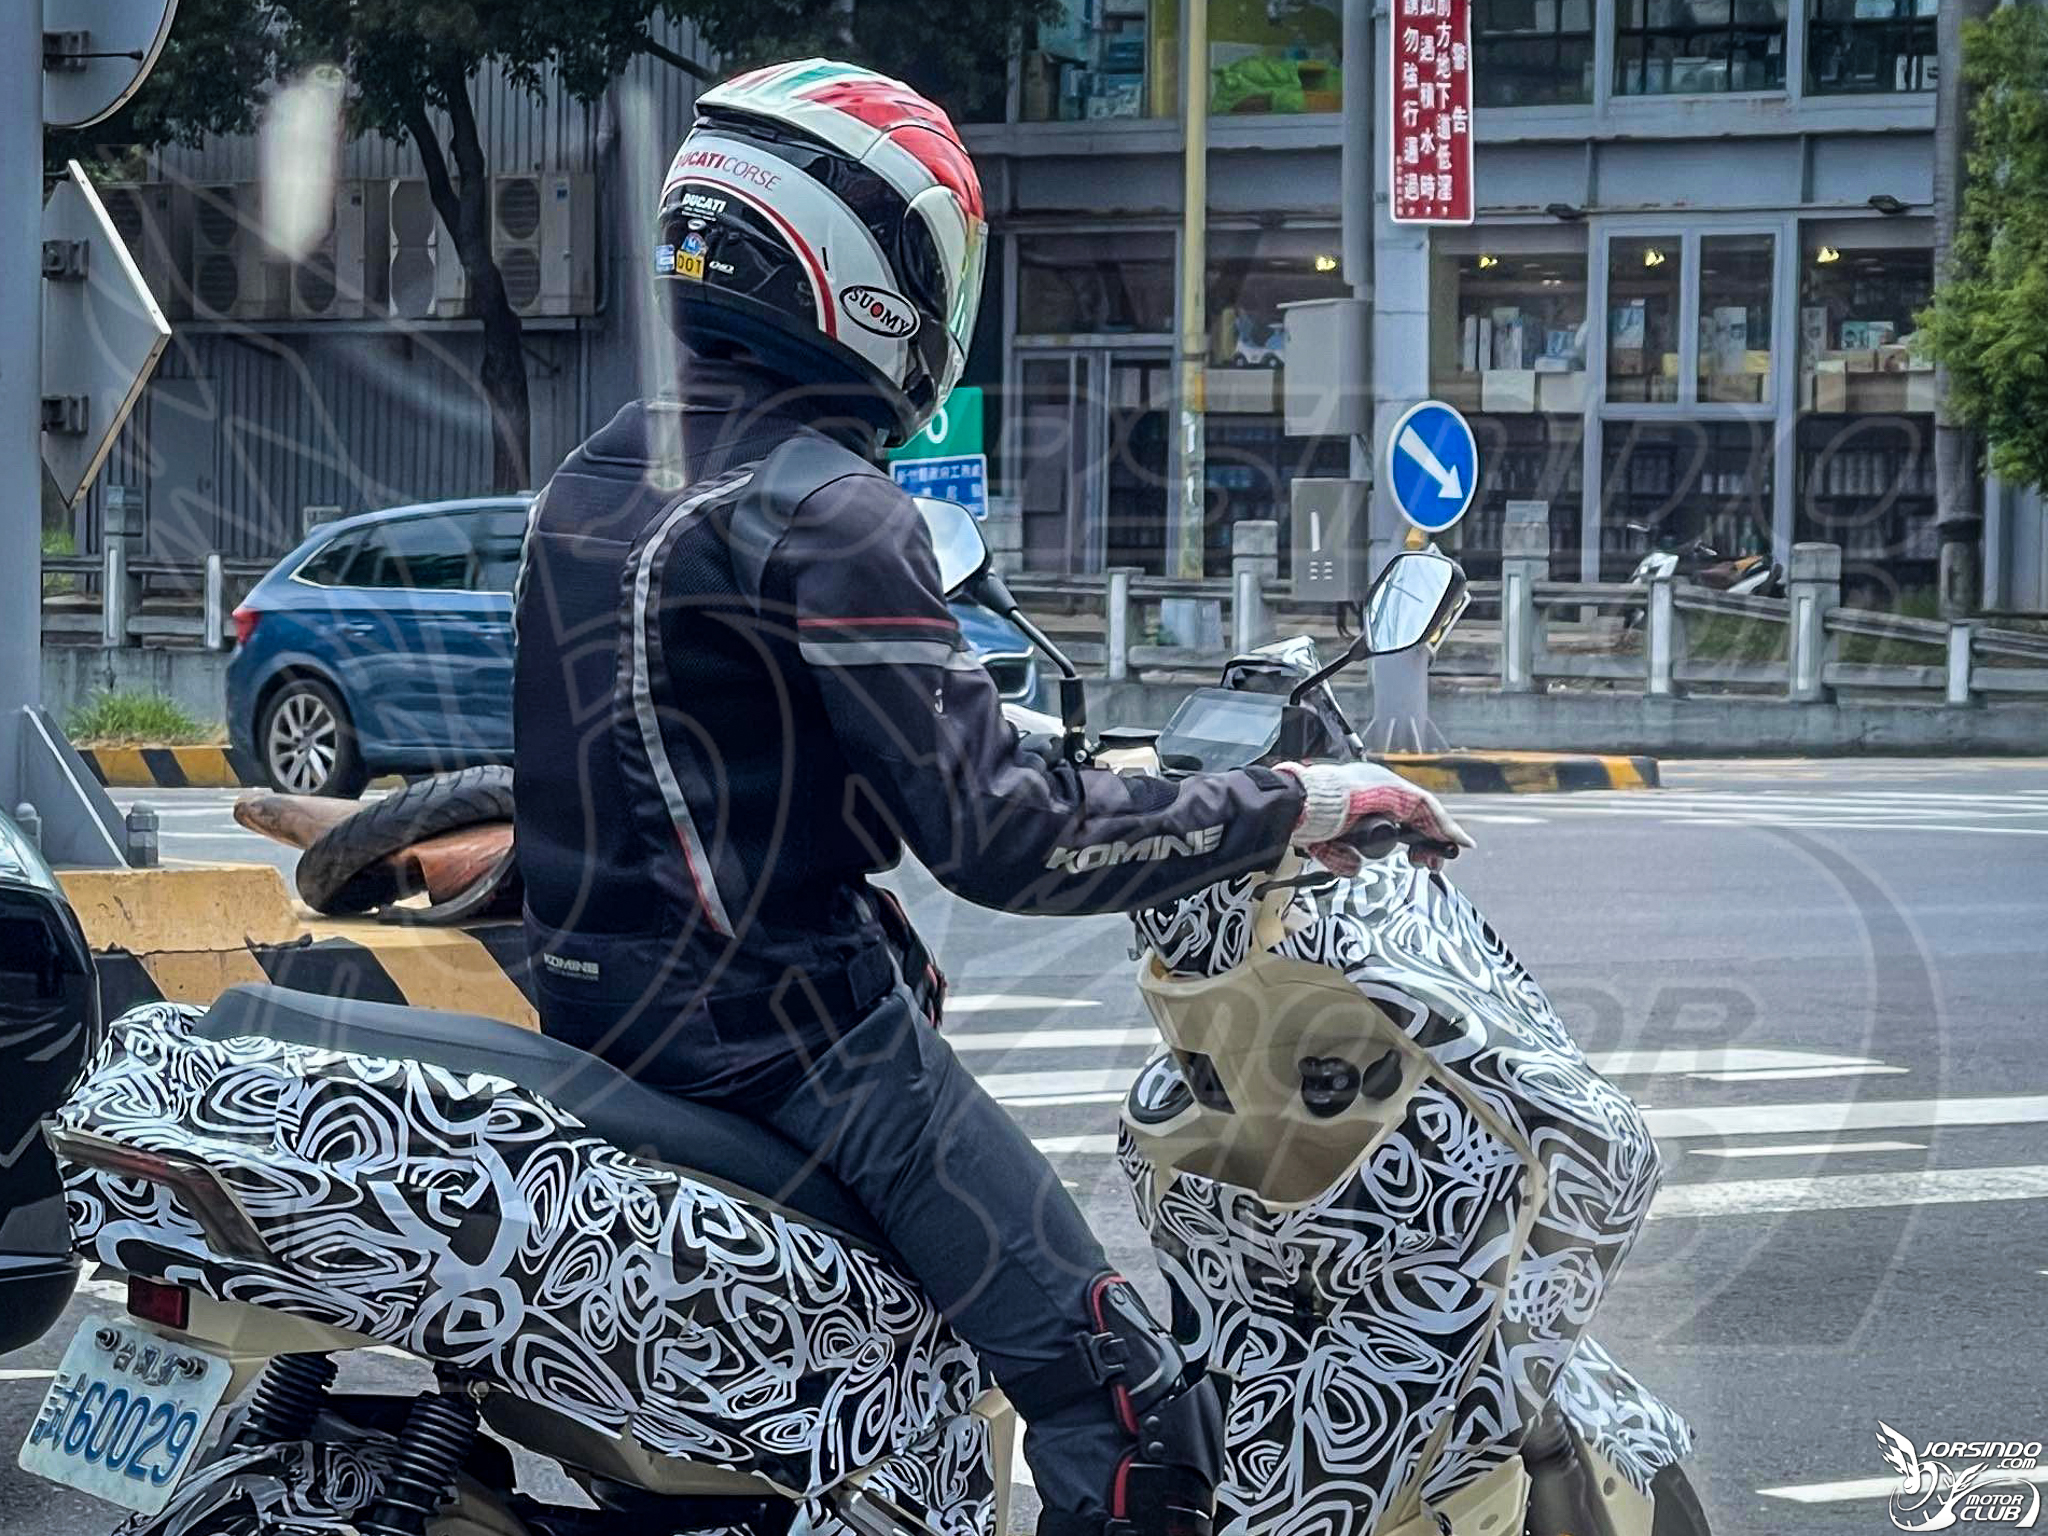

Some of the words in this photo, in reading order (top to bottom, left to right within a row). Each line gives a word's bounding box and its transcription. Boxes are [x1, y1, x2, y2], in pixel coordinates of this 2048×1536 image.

[1451, 42, 1468, 134] 警告
[682, 193, 727, 213] DUCATI
[677, 254, 702, 274] DOT
[848, 287, 910, 334] SUOMY
[1046, 823, 1224, 875] KOMINE
